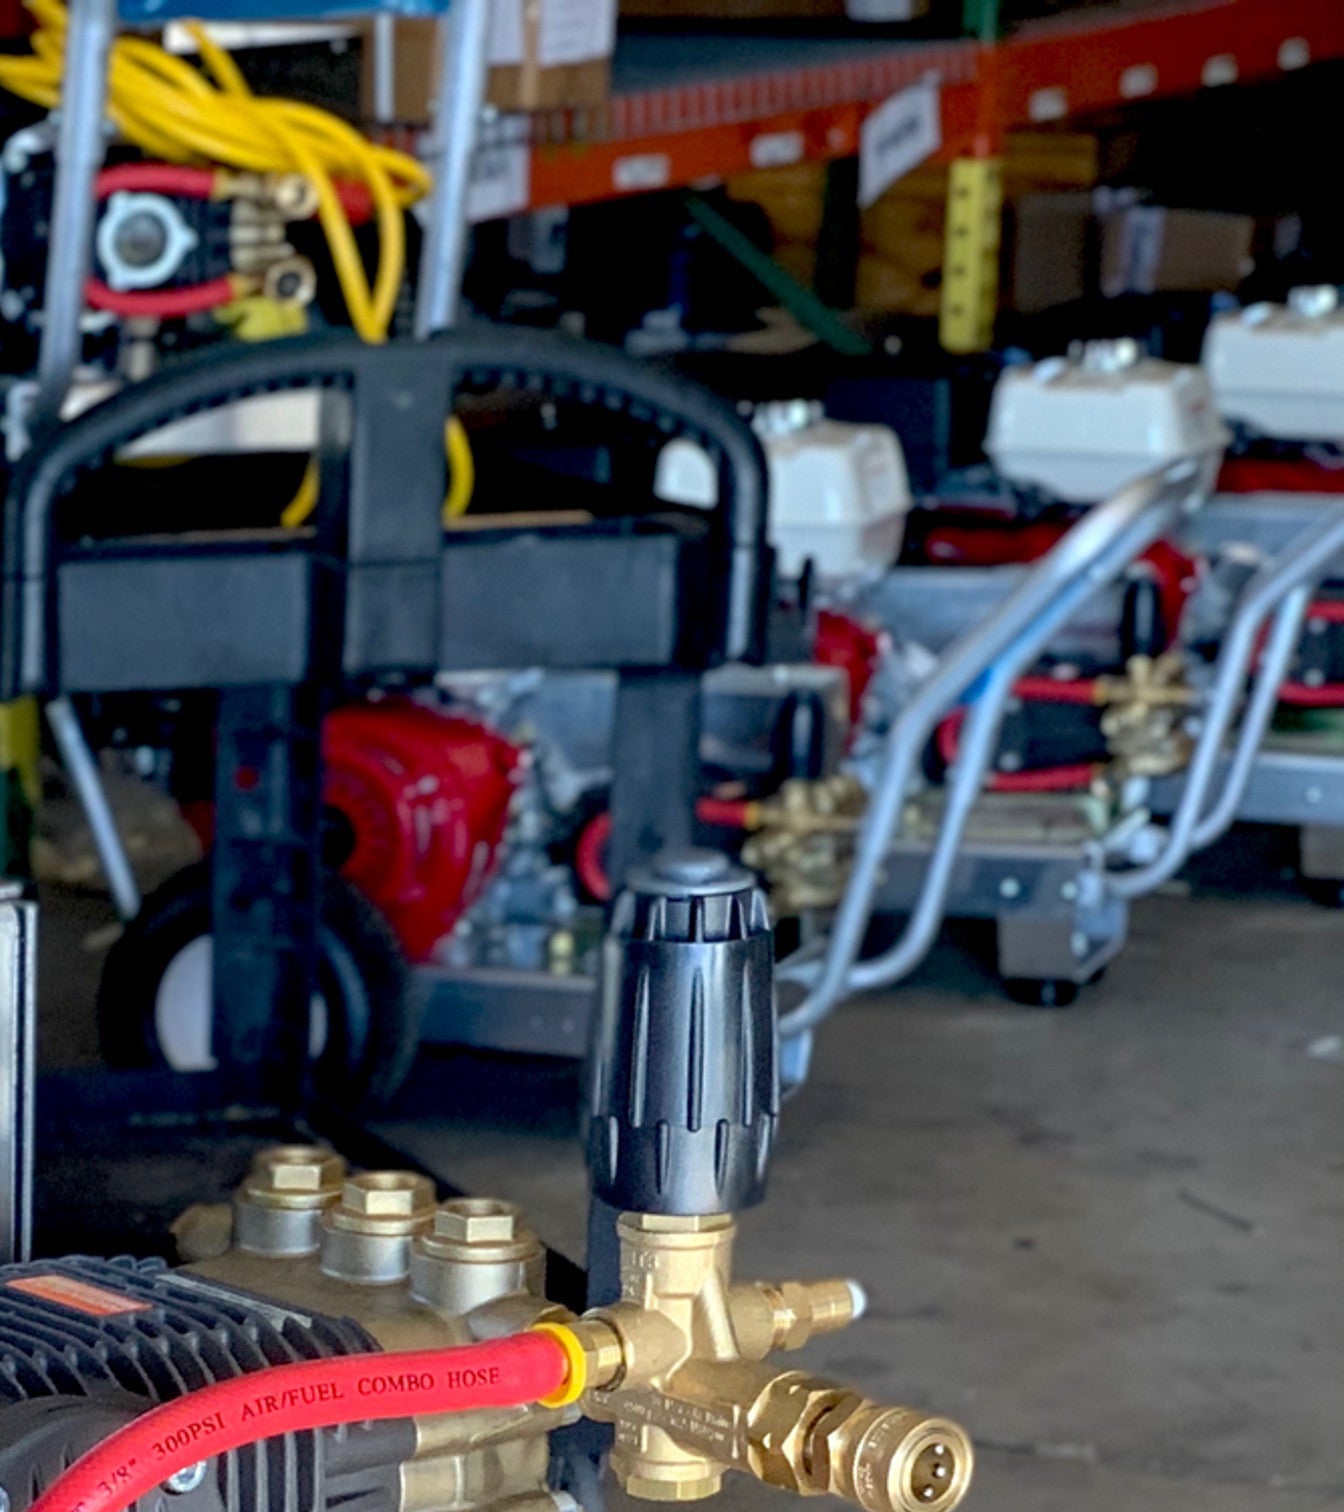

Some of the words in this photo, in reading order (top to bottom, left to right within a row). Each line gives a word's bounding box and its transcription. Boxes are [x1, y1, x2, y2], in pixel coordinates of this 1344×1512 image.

[152, 1413, 226, 1462] 300PSI
[241, 1382, 344, 1422] AIR/FUEL
[357, 1372, 435, 1397] COMBO
[446, 1366, 501, 1390] HOSE
